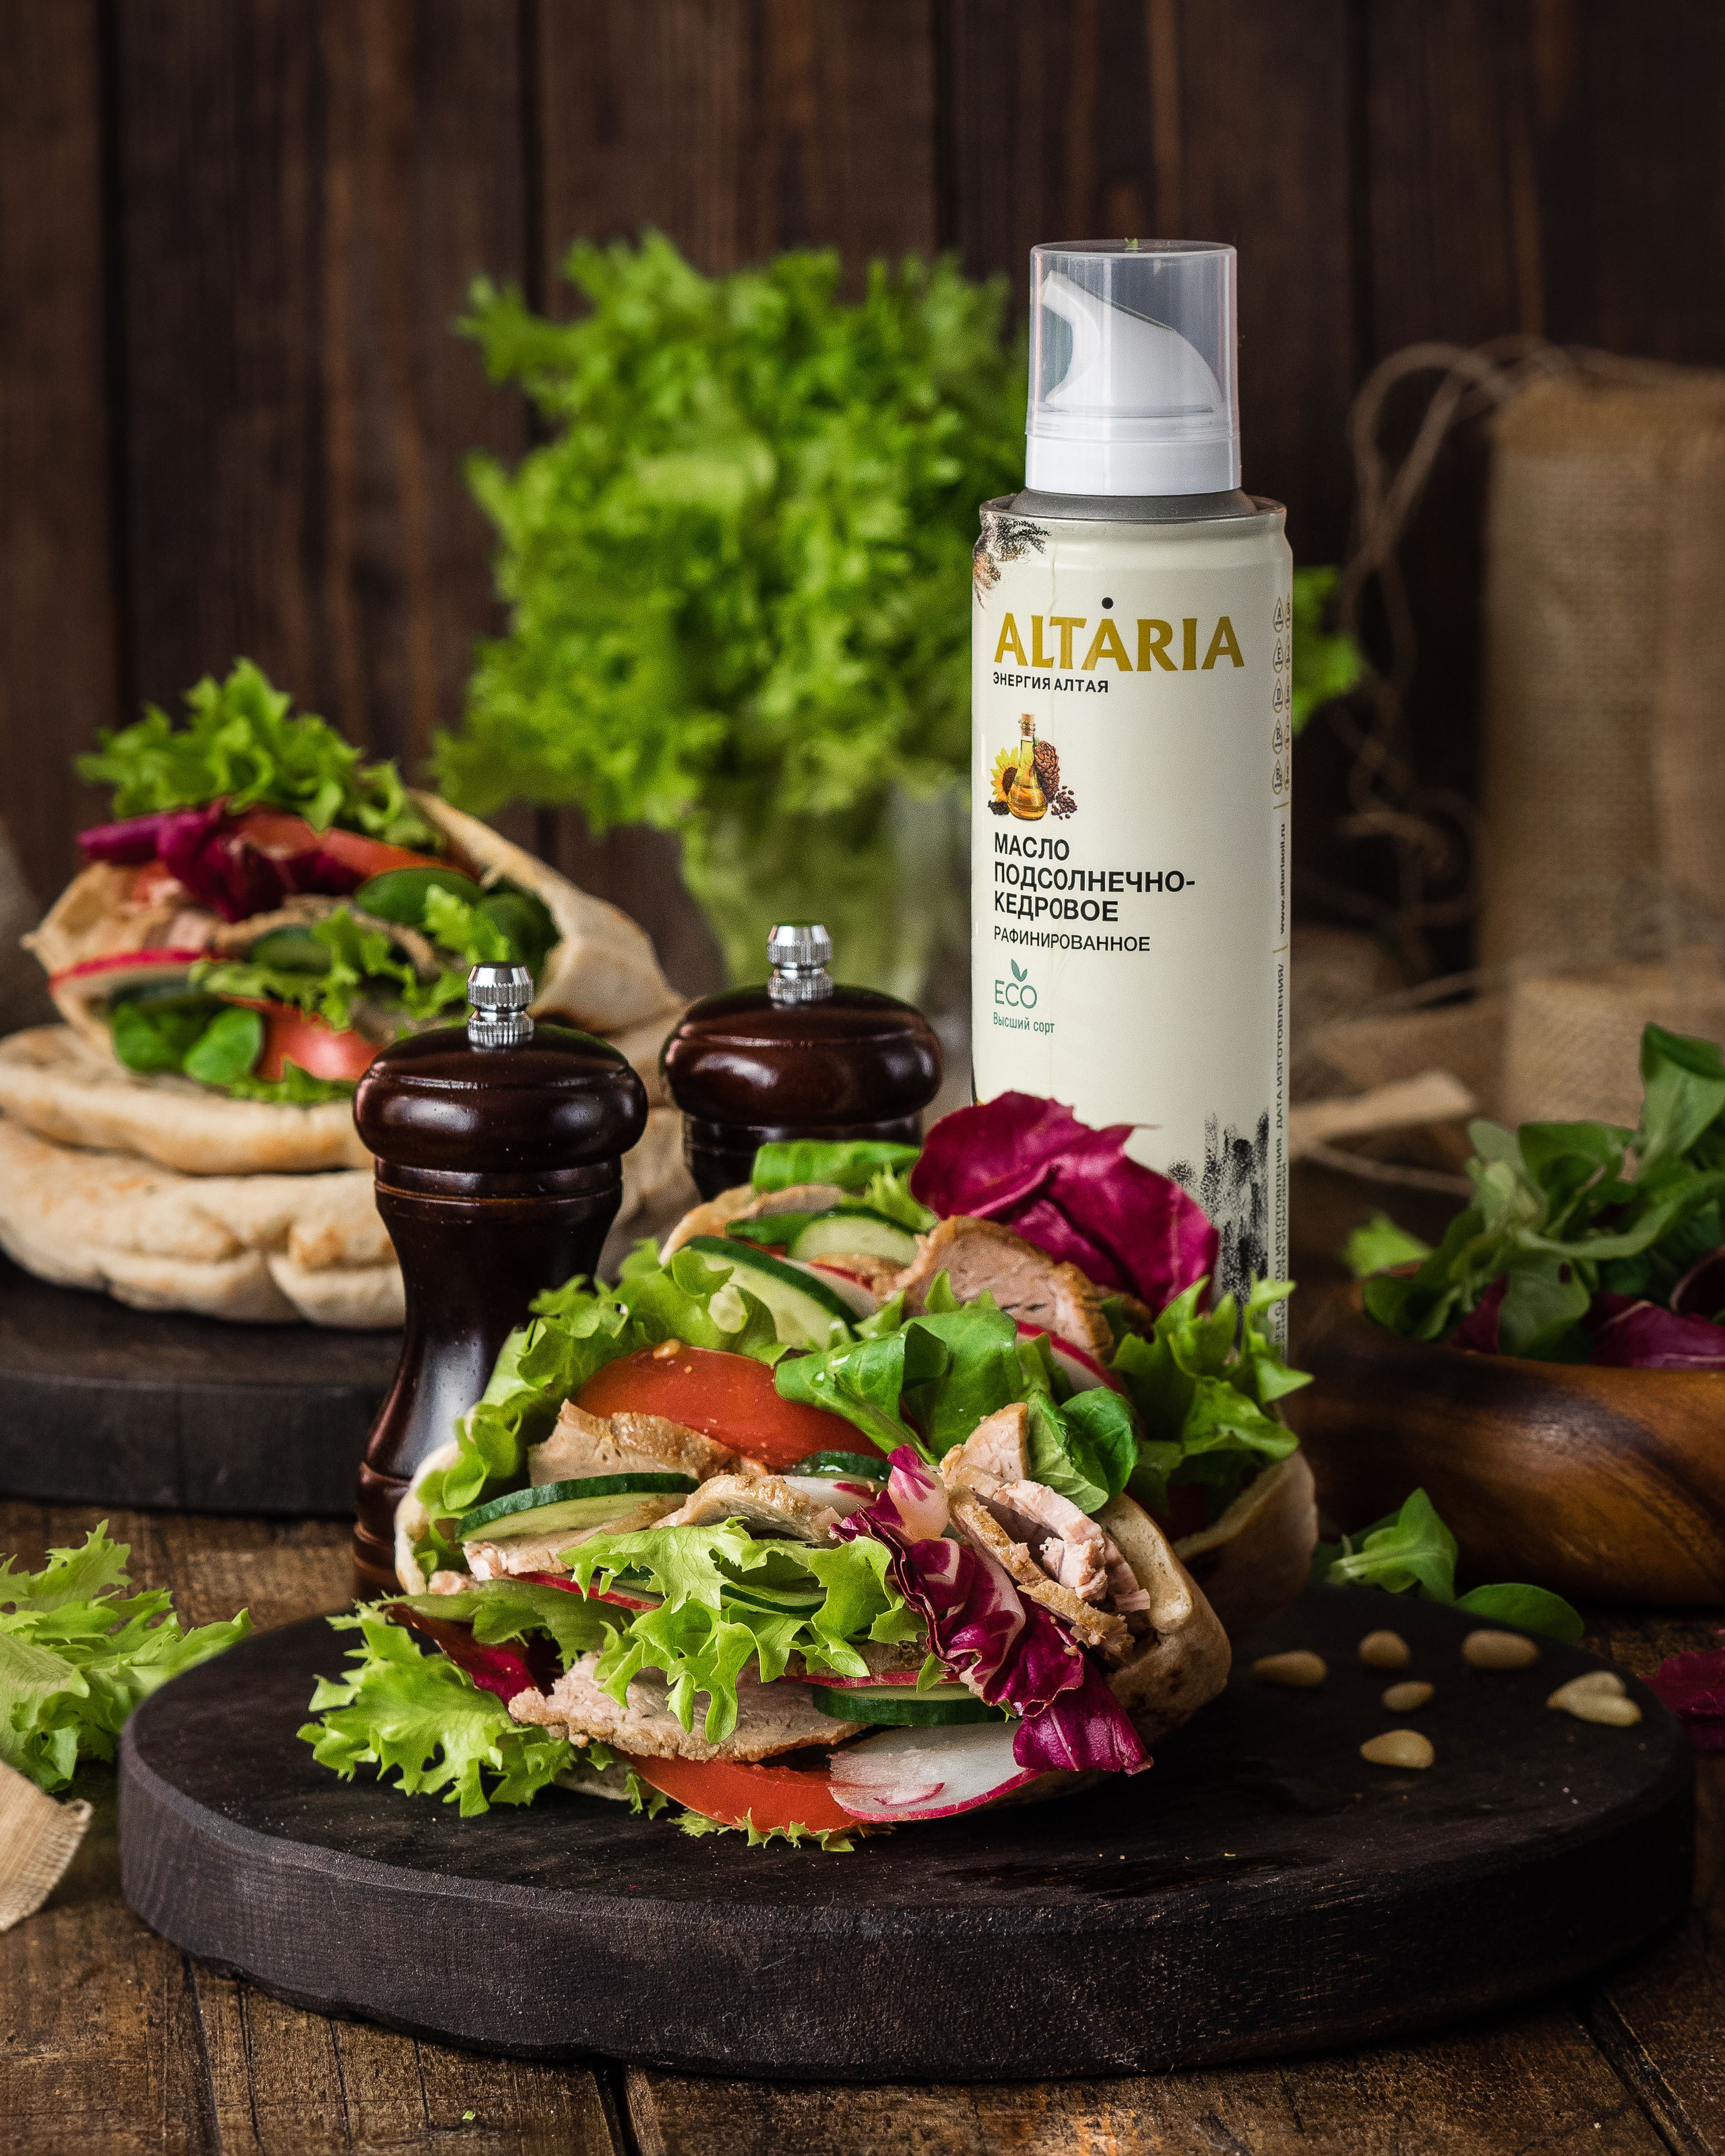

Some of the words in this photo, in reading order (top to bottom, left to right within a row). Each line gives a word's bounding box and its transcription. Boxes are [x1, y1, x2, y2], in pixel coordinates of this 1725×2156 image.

[994, 612, 1245, 672] ALTARIA
[993, 671, 1051, 691] ЭНЕРГИЯ
[1053, 678, 1109, 693] АЛТАЯ
[994, 831, 1070, 861] МАСЛО
[994, 861, 1195, 893] ПОДСОЛНЕЧНО-
[994, 890, 1119, 922] КЕДРОВОЕ
[994, 926, 1151, 953] РАФИНИРОВАННОЕ
[994, 979, 1038, 1009] ECO
[993, 1011, 1031, 1032] Высший
[1033, 1020, 1056, 1037] сорт
